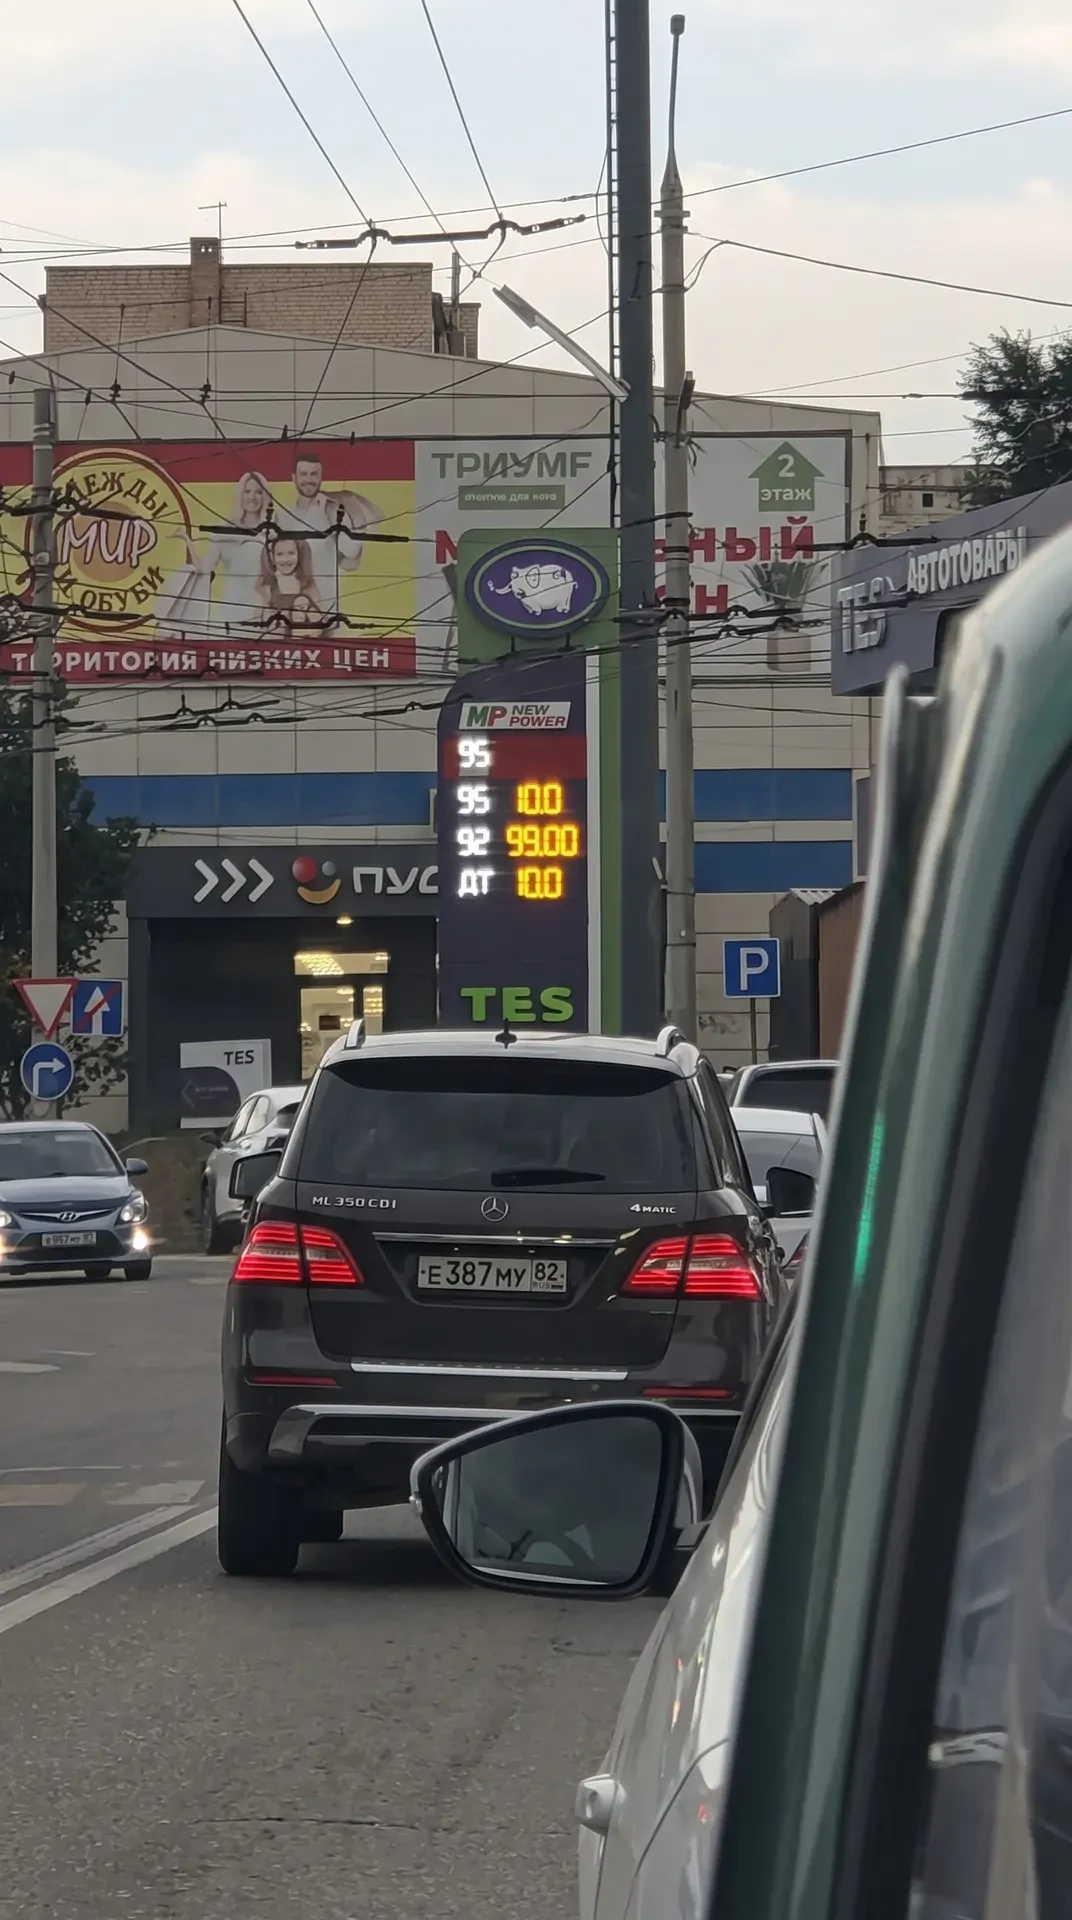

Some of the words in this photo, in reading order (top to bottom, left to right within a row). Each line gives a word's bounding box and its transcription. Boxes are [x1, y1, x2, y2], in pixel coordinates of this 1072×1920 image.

[778, 454, 795, 477] 2
[53, 471, 168, 522] ДЕЖДЫ
[760, 488, 812, 501] этаж
[907, 525, 1026, 594] АВТОТОВАРЫ
[11, 651, 197, 672] ТРРИТОРИЯ
[209, 650, 321, 670] НИЗКИХ
[333, 648, 389, 672] ЦЕН
[466, 705, 507, 727] MP
[512, 705, 550, 715] NEW
[509, 716, 566, 727] POWER
[458, 739, 490, 768] 95
[457, 784, 490, 814] 95
[457, 827, 490, 856] 92
[506, 825, 578, 857] 99.00
[458, 868, 495, 897] ДТ
[740, 947, 769, 990] P
[460, 986, 573, 1022] TES
[224, 1050, 254, 1066] TES
[312, 1197, 331, 1206] ML
[334, 1197, 365, 1207] 350
[368, 1199, 397, 1209] CDI
[534, 1262, 558, 1281] 82
